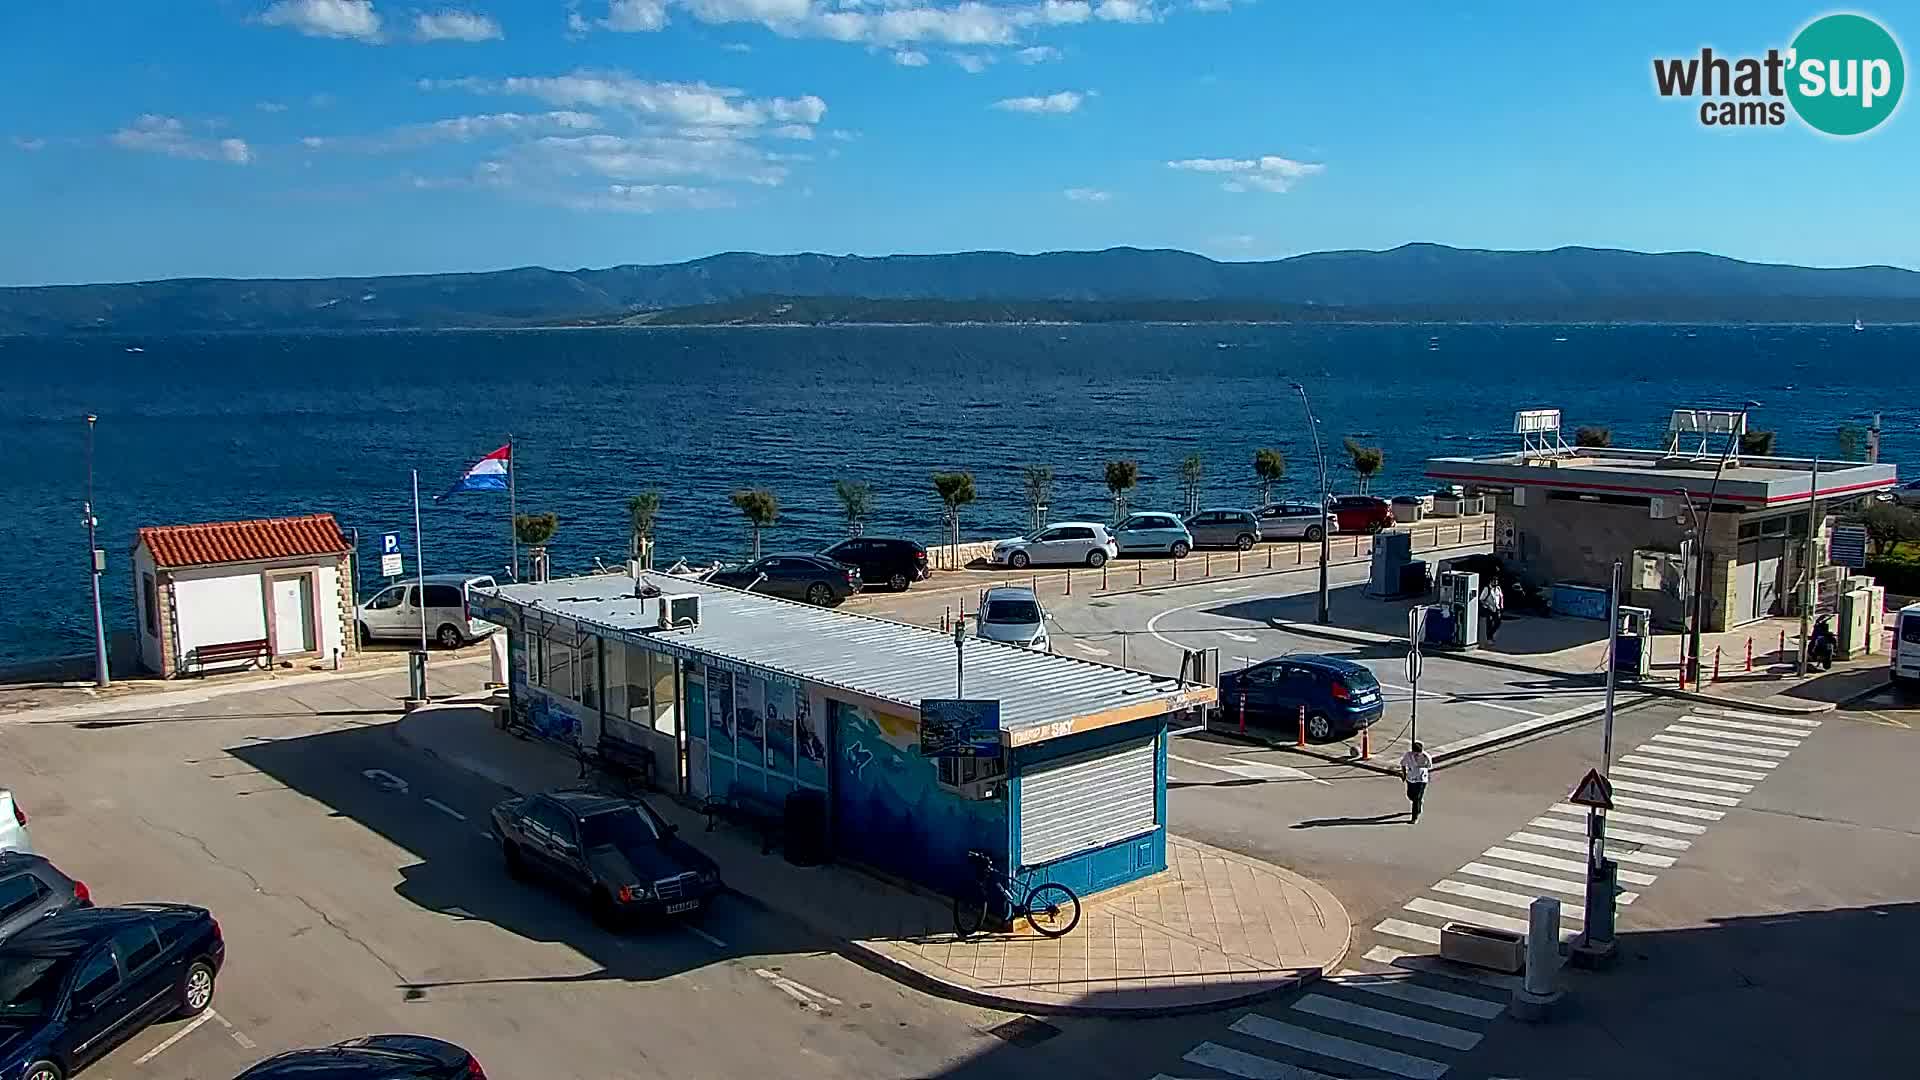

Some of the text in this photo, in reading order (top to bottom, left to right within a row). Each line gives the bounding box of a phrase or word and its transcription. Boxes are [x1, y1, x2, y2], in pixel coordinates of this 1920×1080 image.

[385, 535, 397, 552] P
[718, 660, 747, 674] STATION
[750, 667, 773, 682] TICKET
[774, 674, 800, 688] OFFICE
